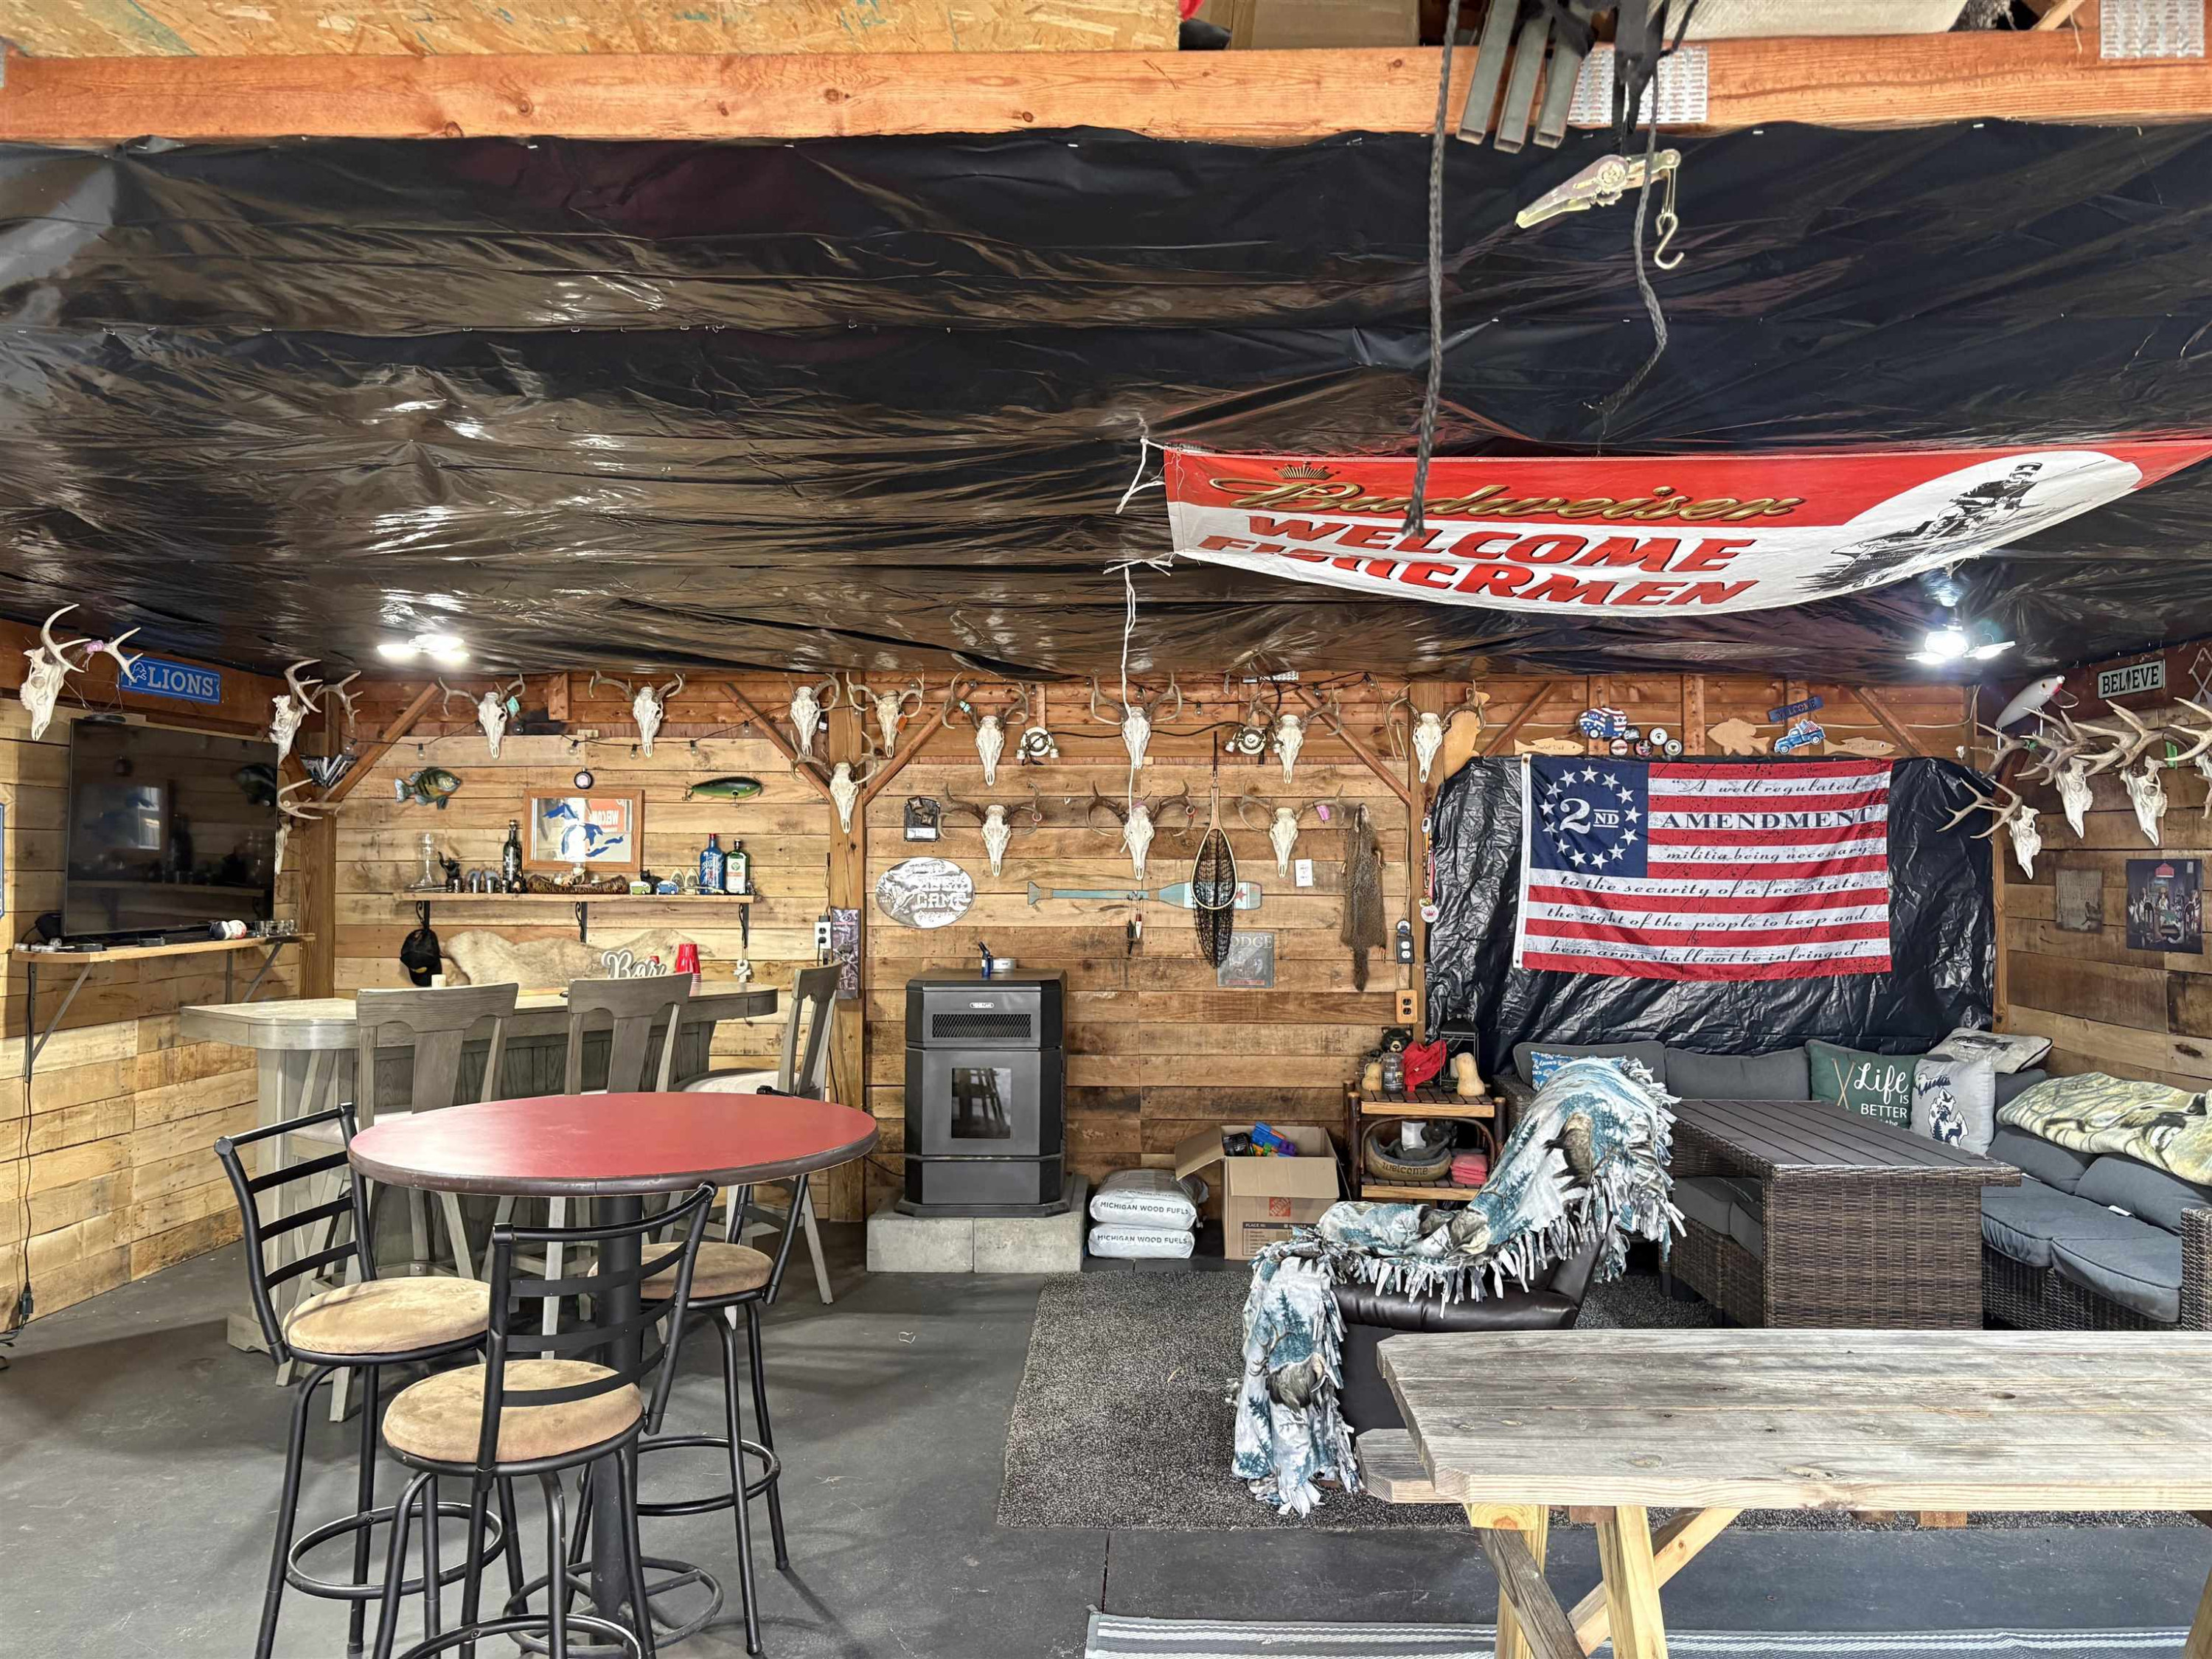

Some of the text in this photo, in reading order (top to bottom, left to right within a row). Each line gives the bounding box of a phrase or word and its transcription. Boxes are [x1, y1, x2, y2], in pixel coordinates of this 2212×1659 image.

[1209, 478, 1805, 521] Budweiser
[1246, 515, 1756, 572] WELCOME
[147, 666, 213, 697] LIONS
[1719, 779, 1761, 793] well
[1764, 777, 1860, 796] regulated
[1662, 807, 1873, 829] AMENDMENT
[1667, 846, 1866, 862] militia being necessary
[1561, 876, 1579, 886] to
[1586, 877, 1616, 891] the
[1624, 884, 1709, 898] security
[1718, 879, 1742, 898] of
[1763, 880, 1804, 898] free
[1548, 905, 1867, 931] the right of the people to keep and
[1231, 936, 1273, 948] ODGE
[1551, 939, 1591, 954] bear
[1597, 950, 1644, 960] arms
[1652, 948, 1703, 962] shall
[1704, 953, 1737, 962] not
[1742, 950, 1761, 962] be
[601, 948, 667, 979] Bar
[1854, 1062, 1908, 1105] Life
[1899, 1094, 1909, 1105] IS
[1860, 1103, 1907, 1119] BETTER
[1382, 1162, 1428, 1175] welcome
[1100, 1201, 1138, 1211] MICHIGAN
[1140, 1205, 1164, 1213] WOOD
[1097, 1234, 1135, 1242] MICHIGAN
